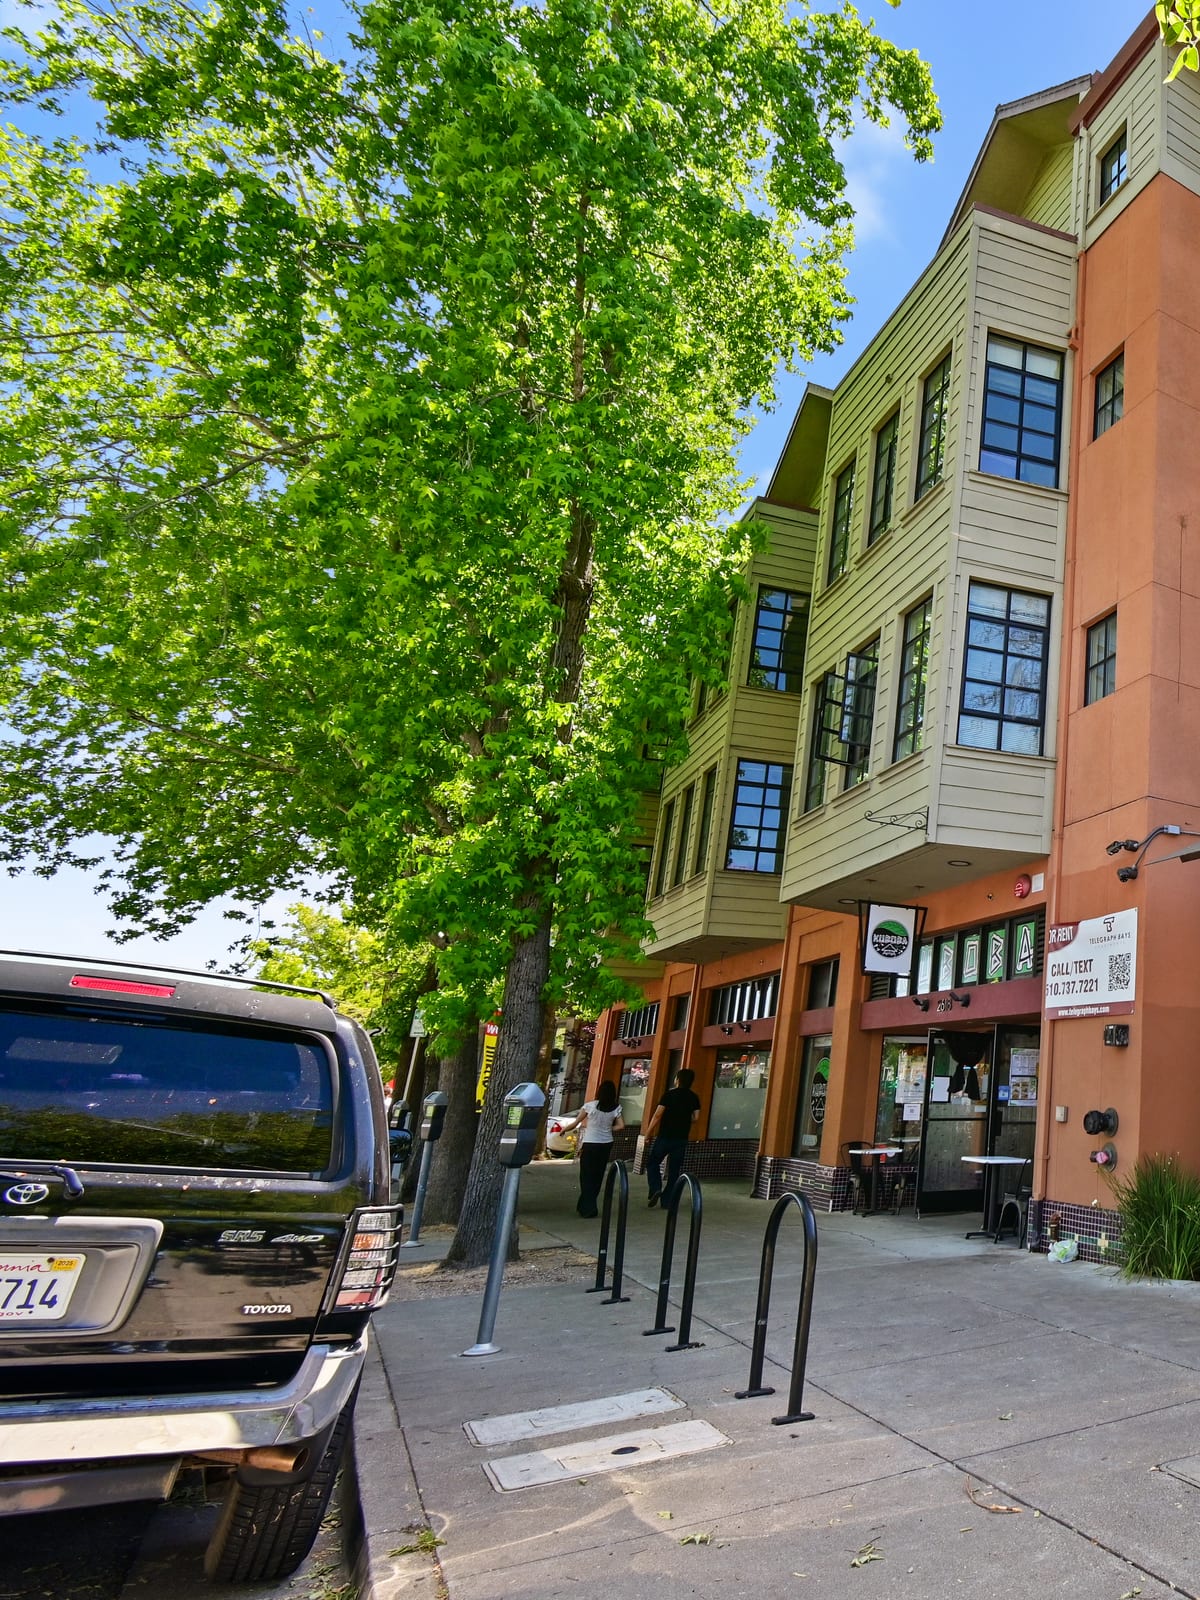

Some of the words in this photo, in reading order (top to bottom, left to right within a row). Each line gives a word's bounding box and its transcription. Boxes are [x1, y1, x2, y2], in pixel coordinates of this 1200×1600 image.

[1057, 926, 1073, 942] RENT
[1089, 935, 1116, 944] TELEGRAPH
[1117, 932, 1131, 940] BAYS
[1051, 959, 1093, 977] CALL/TEXT
[218, 1229, 266, 1242] SR5
[270, 1234, 325, 1243] 4WD
[0, 1278, 58, 1309] 714
[243, 1304, 292, 1314] TOYOTA
